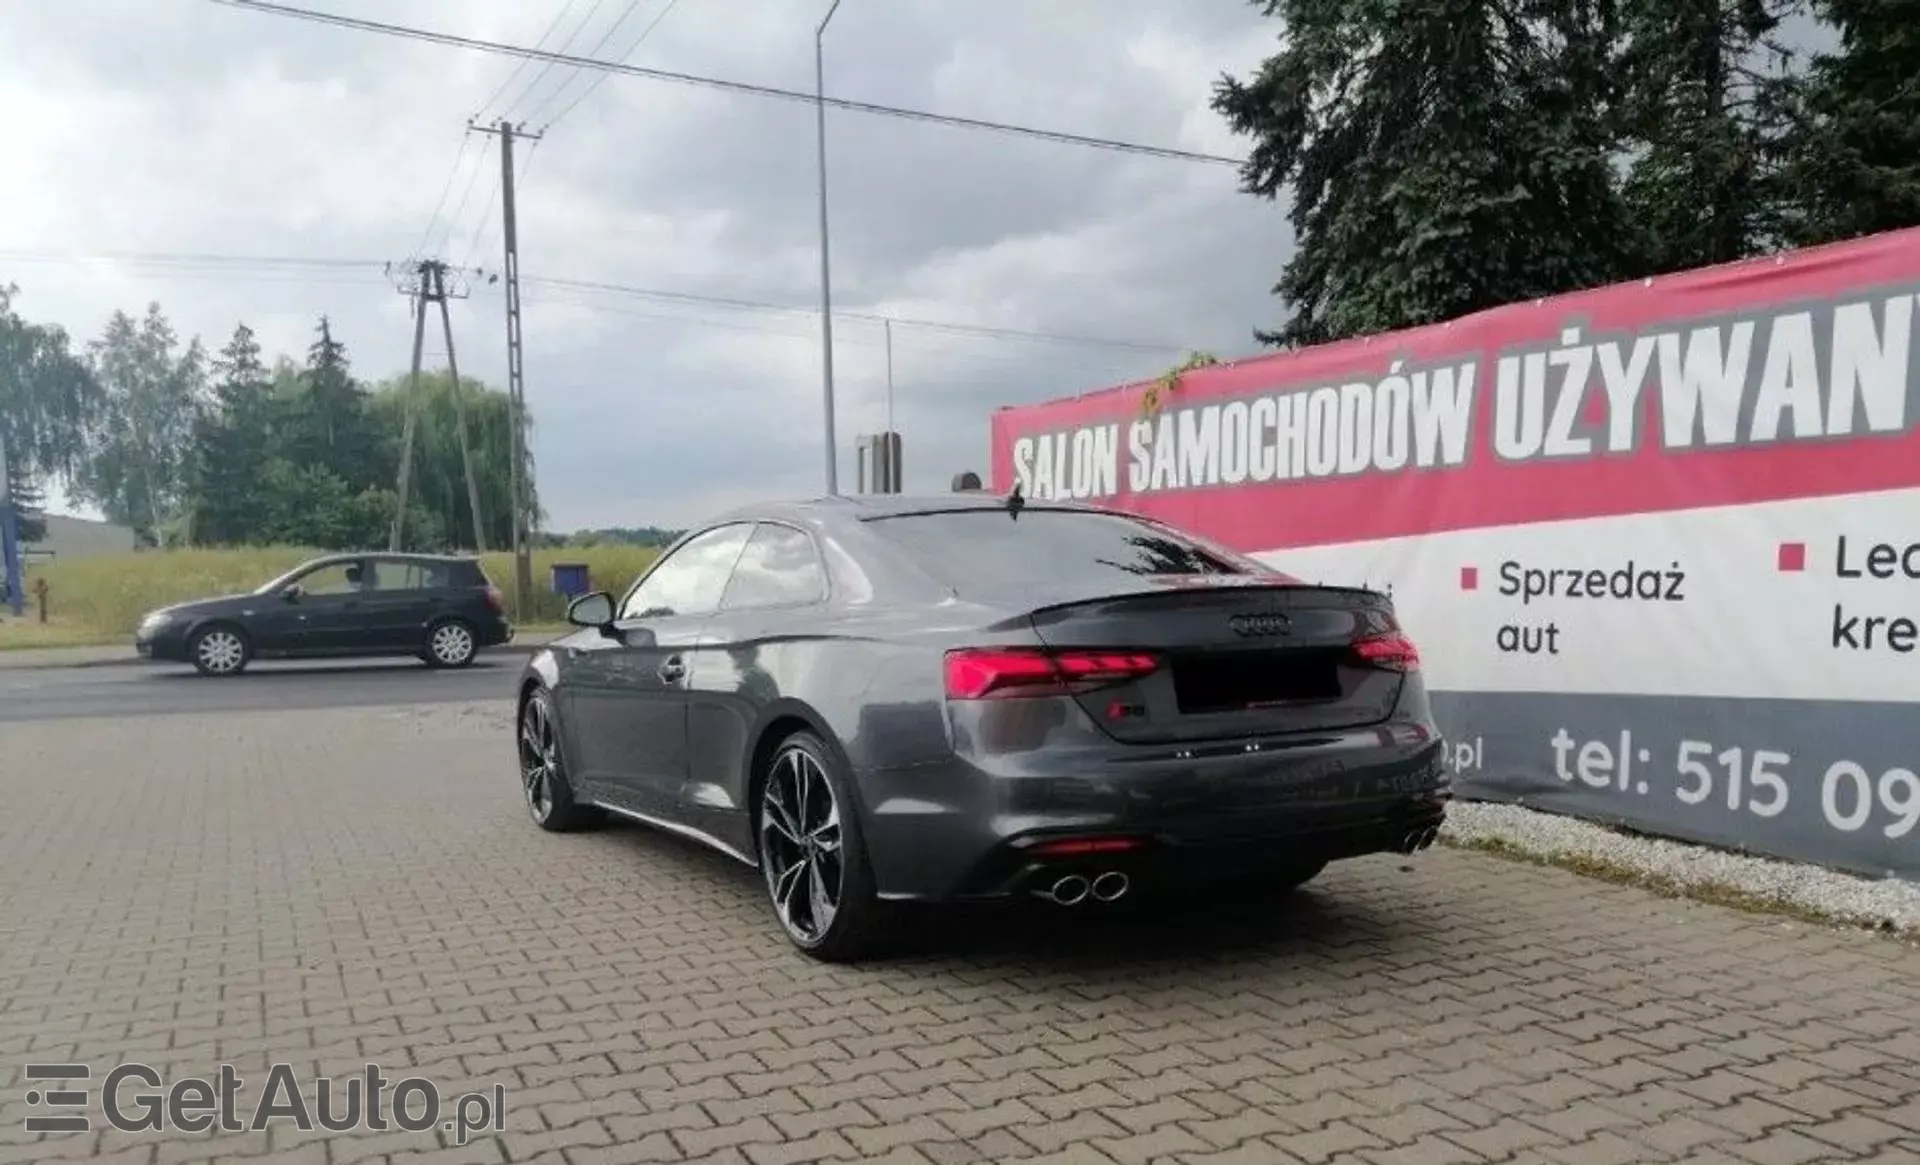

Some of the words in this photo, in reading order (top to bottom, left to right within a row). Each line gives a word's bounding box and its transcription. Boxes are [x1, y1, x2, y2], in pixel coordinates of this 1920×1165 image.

[1014, 423, 1119, 500] SALON
[1129, 360, 1476, 492] SAMOCHODÓW
[1495, 293, 1920, 460] UŻYWAN
[1499, 561, 1685, 604] Sprzedaż
[1496, 622, 1559, 654] aut
[1832, 603, 1918, 653] kre
[1551, 728, 1650, 795] tel:
[1676, 740, 1791, 817] 515
[1822, 760, 1920, 838] 09
